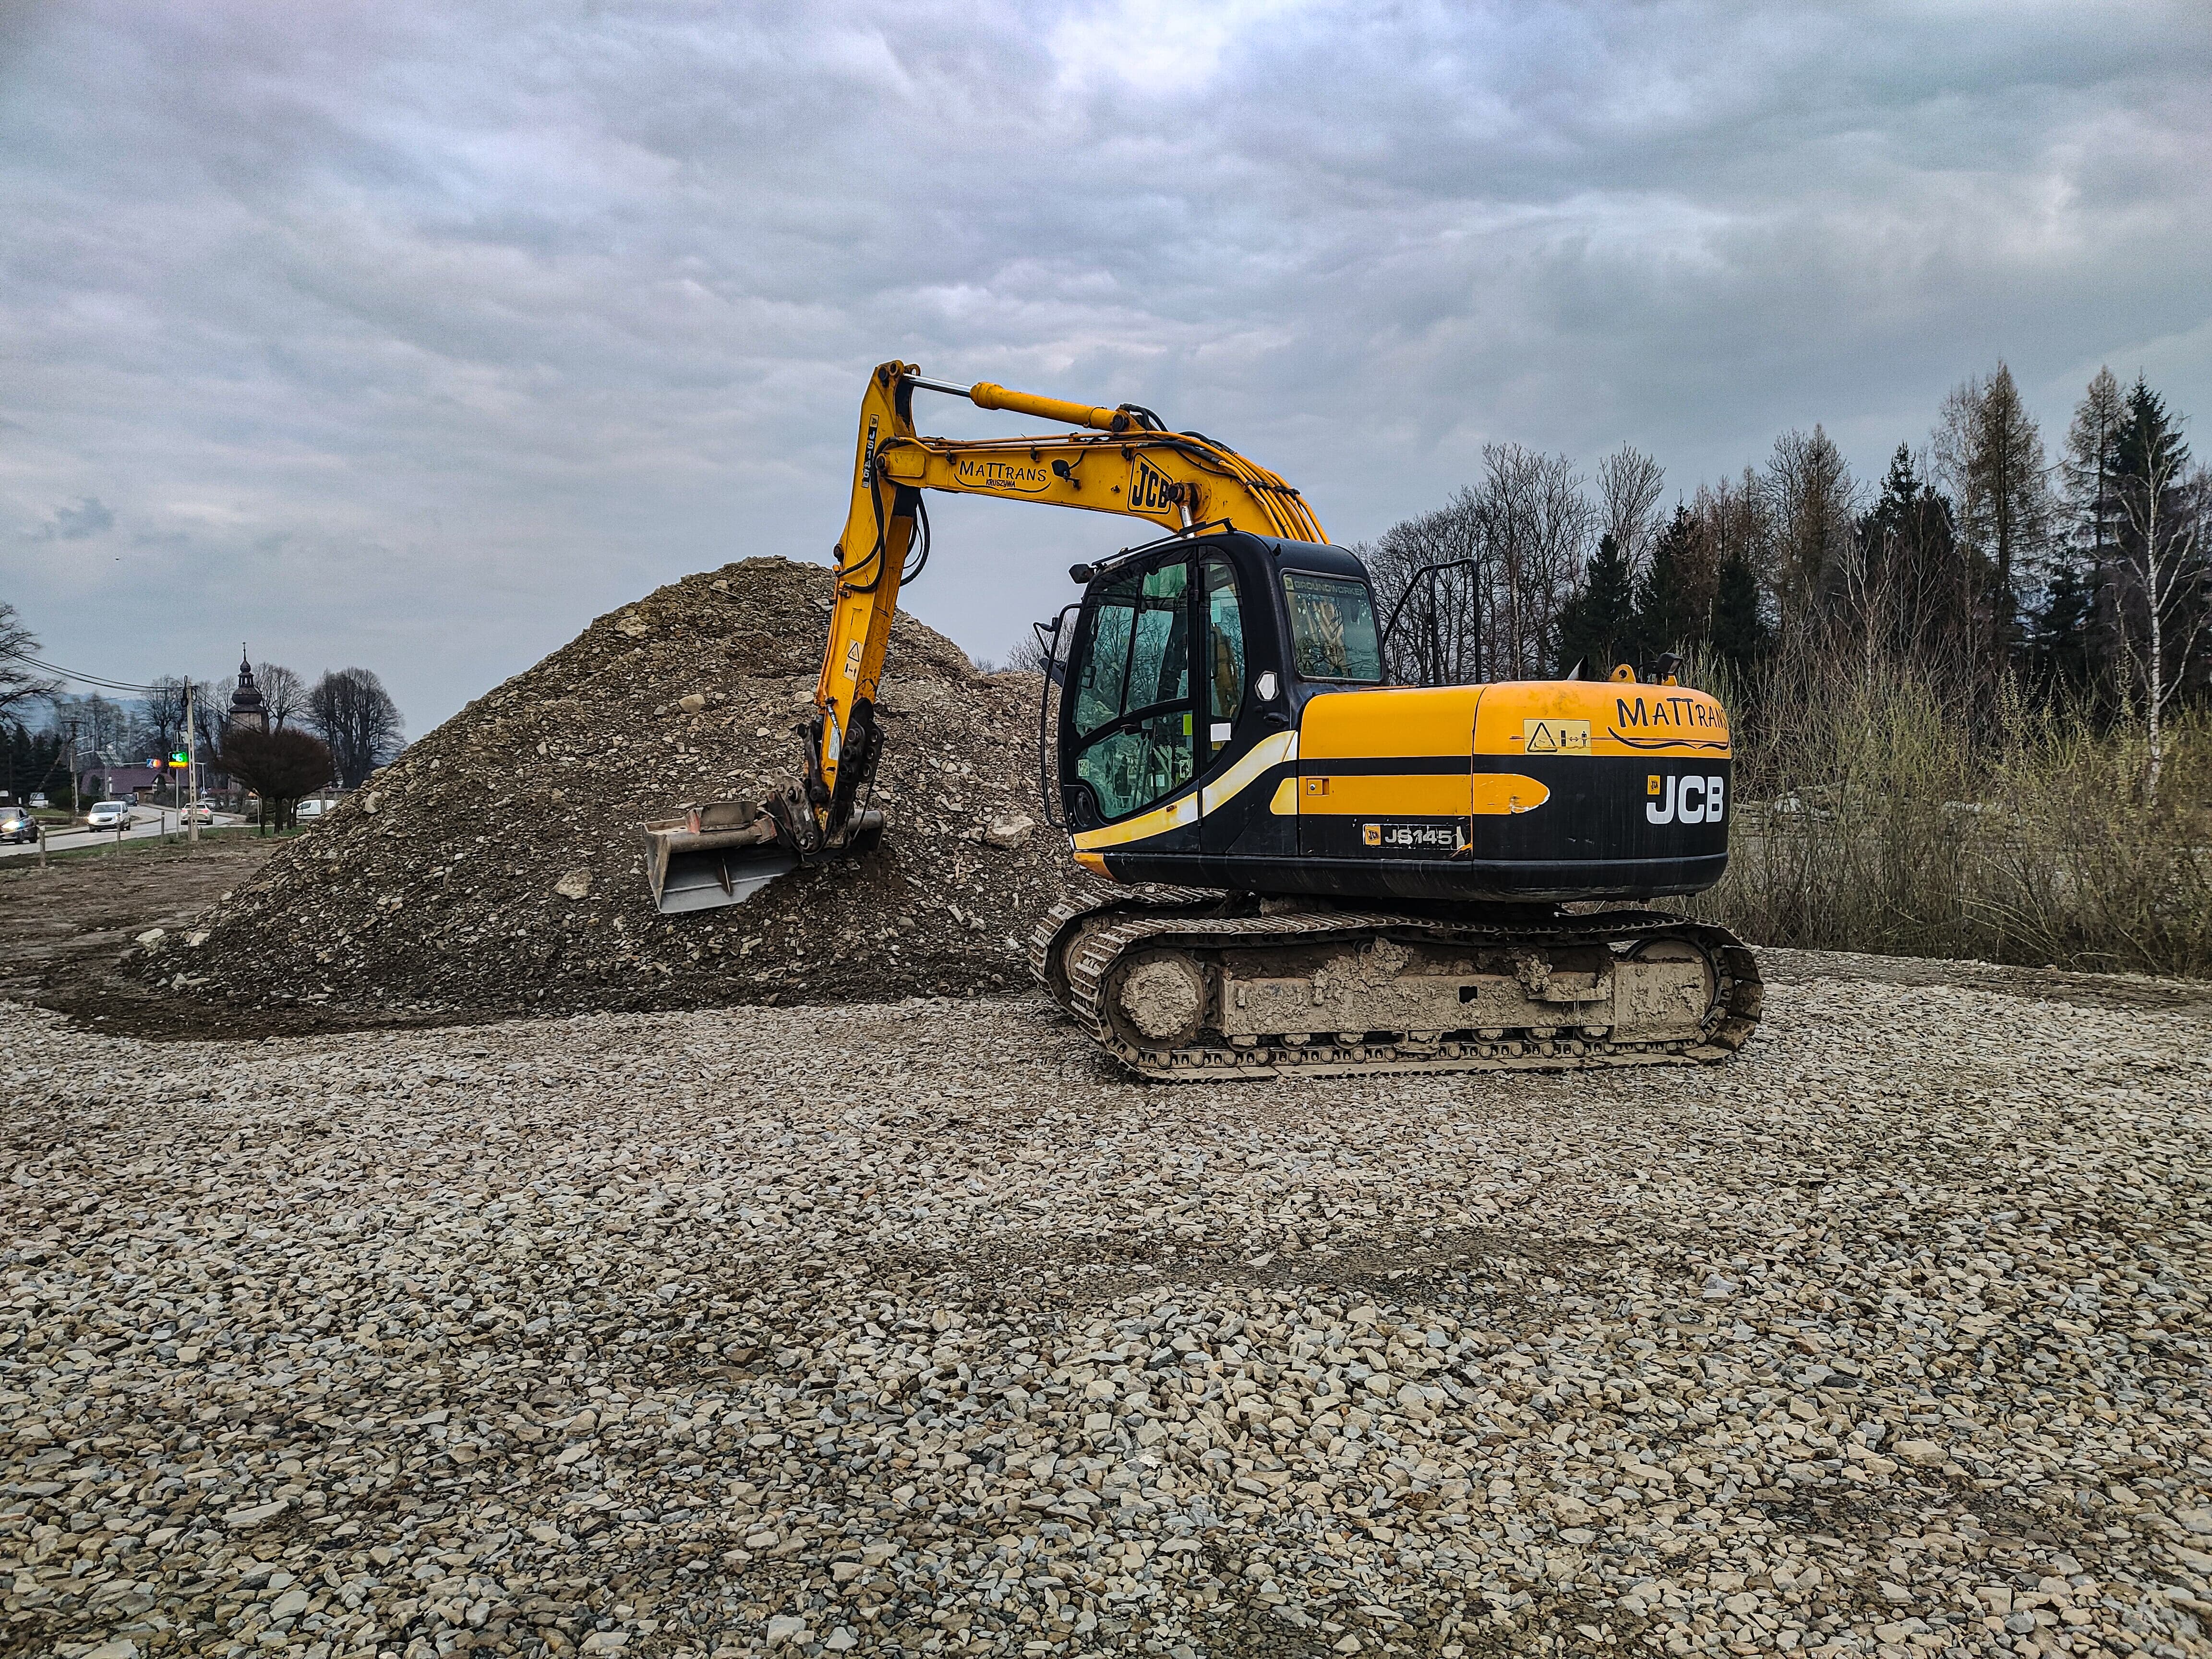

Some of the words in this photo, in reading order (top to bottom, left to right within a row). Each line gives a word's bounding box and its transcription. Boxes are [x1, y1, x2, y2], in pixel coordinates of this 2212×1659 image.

[960, 460, 1047, 481] MATTRANS
[986, 479, 1016, 488] KRUSZYWA
[1131, 461, 1170, 508] JCB
[1294, 580, 1366, 596] GROUNDWORKER
[1616, 697, 1727, 730] MATTRANS
[1647, 775, 1724, 824] JCB
[1368, 830, 1379, 840] JCB
[1384, 829, 1453, 844] JS145
